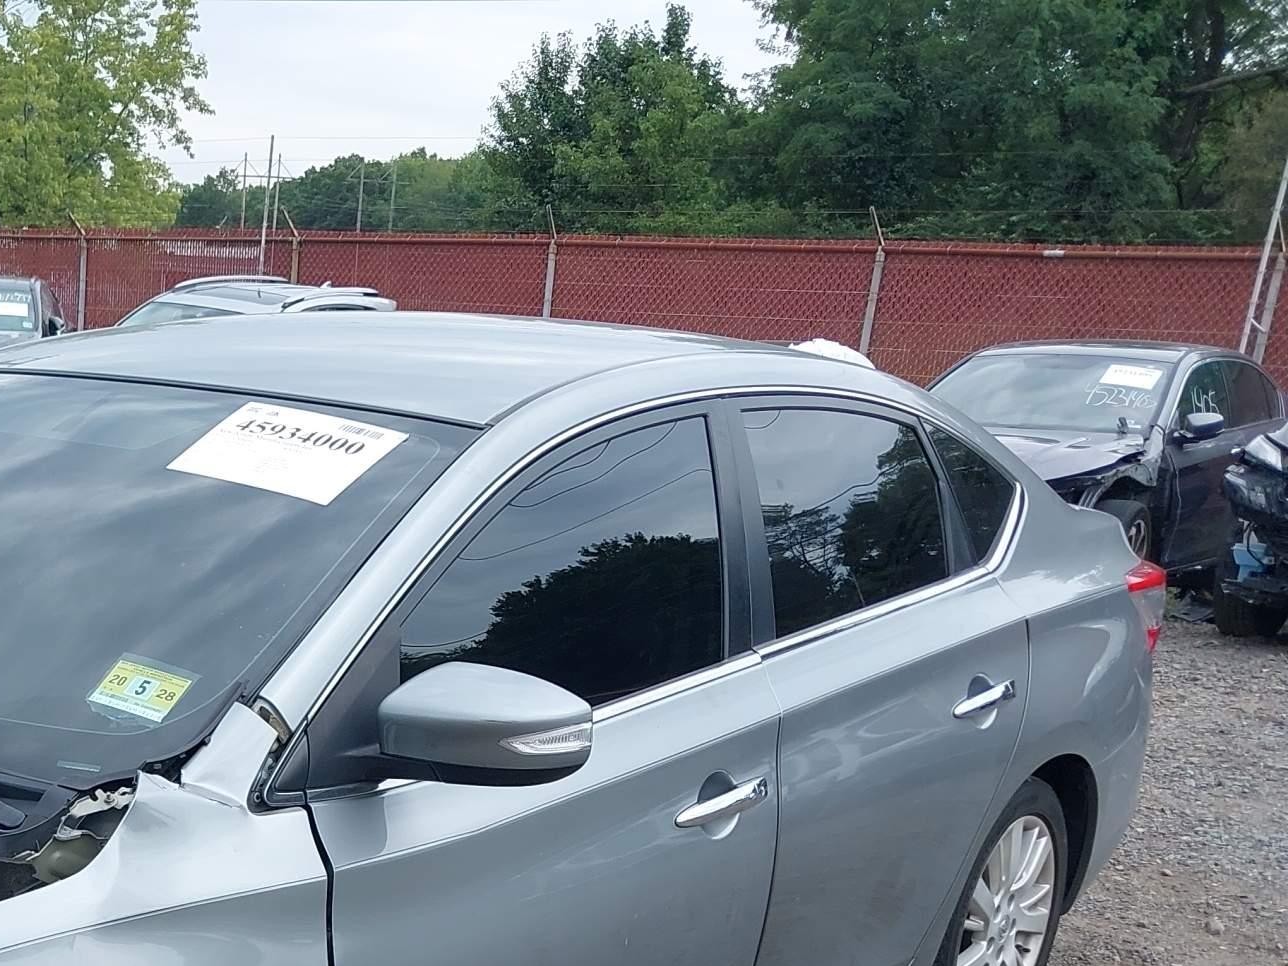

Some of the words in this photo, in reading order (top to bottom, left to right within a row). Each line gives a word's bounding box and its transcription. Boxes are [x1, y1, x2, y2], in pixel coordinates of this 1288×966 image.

[236, 419, 366, 455] 45934000
[108, 674, 128, 687] 20
[134, 679, 151, 696] 5
[155, 688, 177, 702] 28
